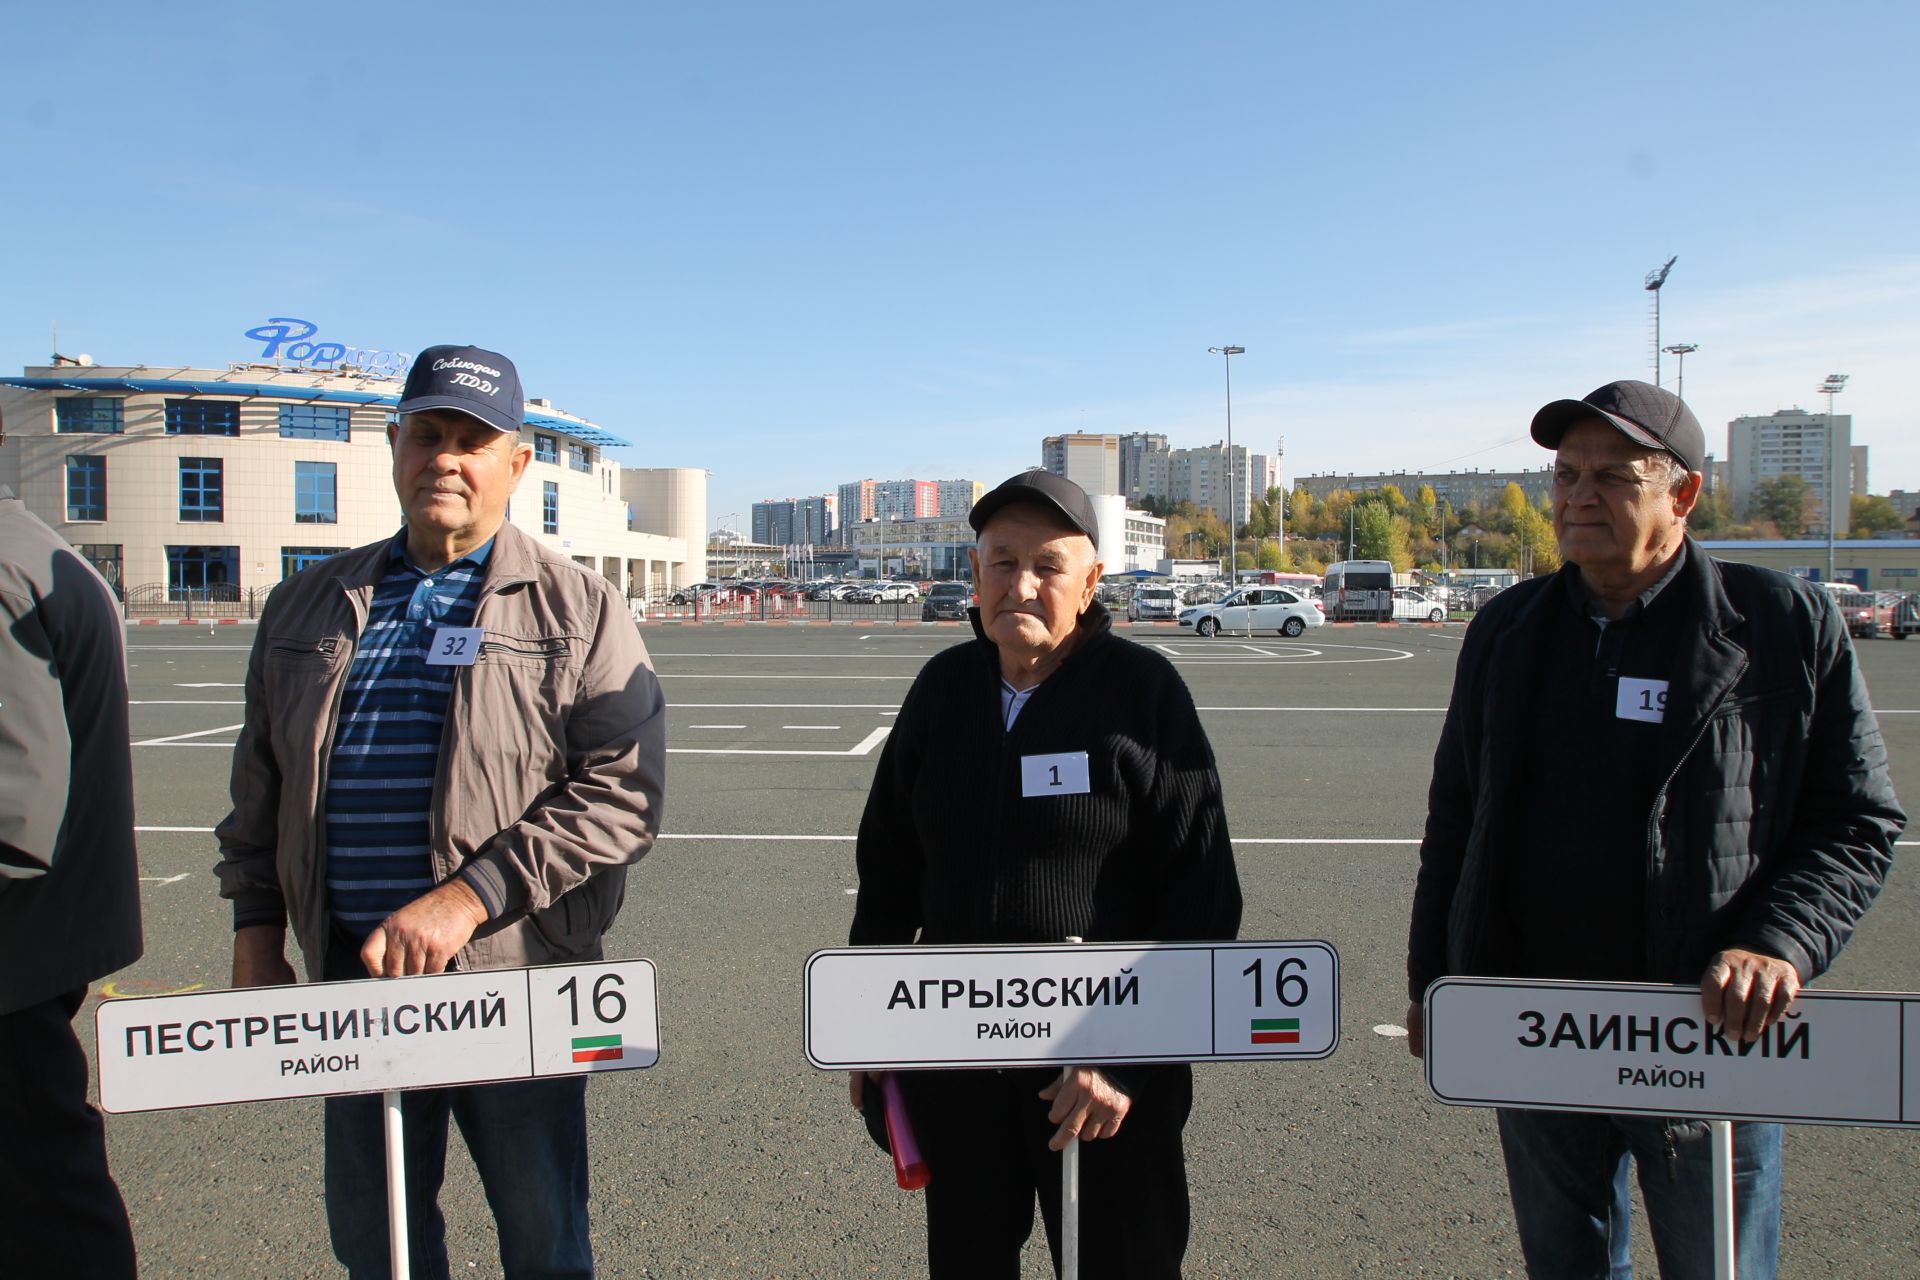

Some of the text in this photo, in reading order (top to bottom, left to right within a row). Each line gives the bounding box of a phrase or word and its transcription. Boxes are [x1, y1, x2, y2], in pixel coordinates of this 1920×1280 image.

[432, 357, 502, 378] Соблюдаю
[449, 373, 500, 397] ПДД!
[442, 636, 467, 656] 32
[1048, 764, 1063, 786] 1
[887, 968, 1140, 1010] АГРЫЗСКИЙ
[1242, 957, 1309, 1008] 16
[556, 973, 628, 1026] 16
[126, 990, 506, 1057] ПЕСТРЕЧИНСКИЙ
[976, 1018, 1051, 1040] РАЙОН
[280, 1053, 360, 1077] РАЙОН
[1618, 1064, 1706, 1089] РАЙОН
